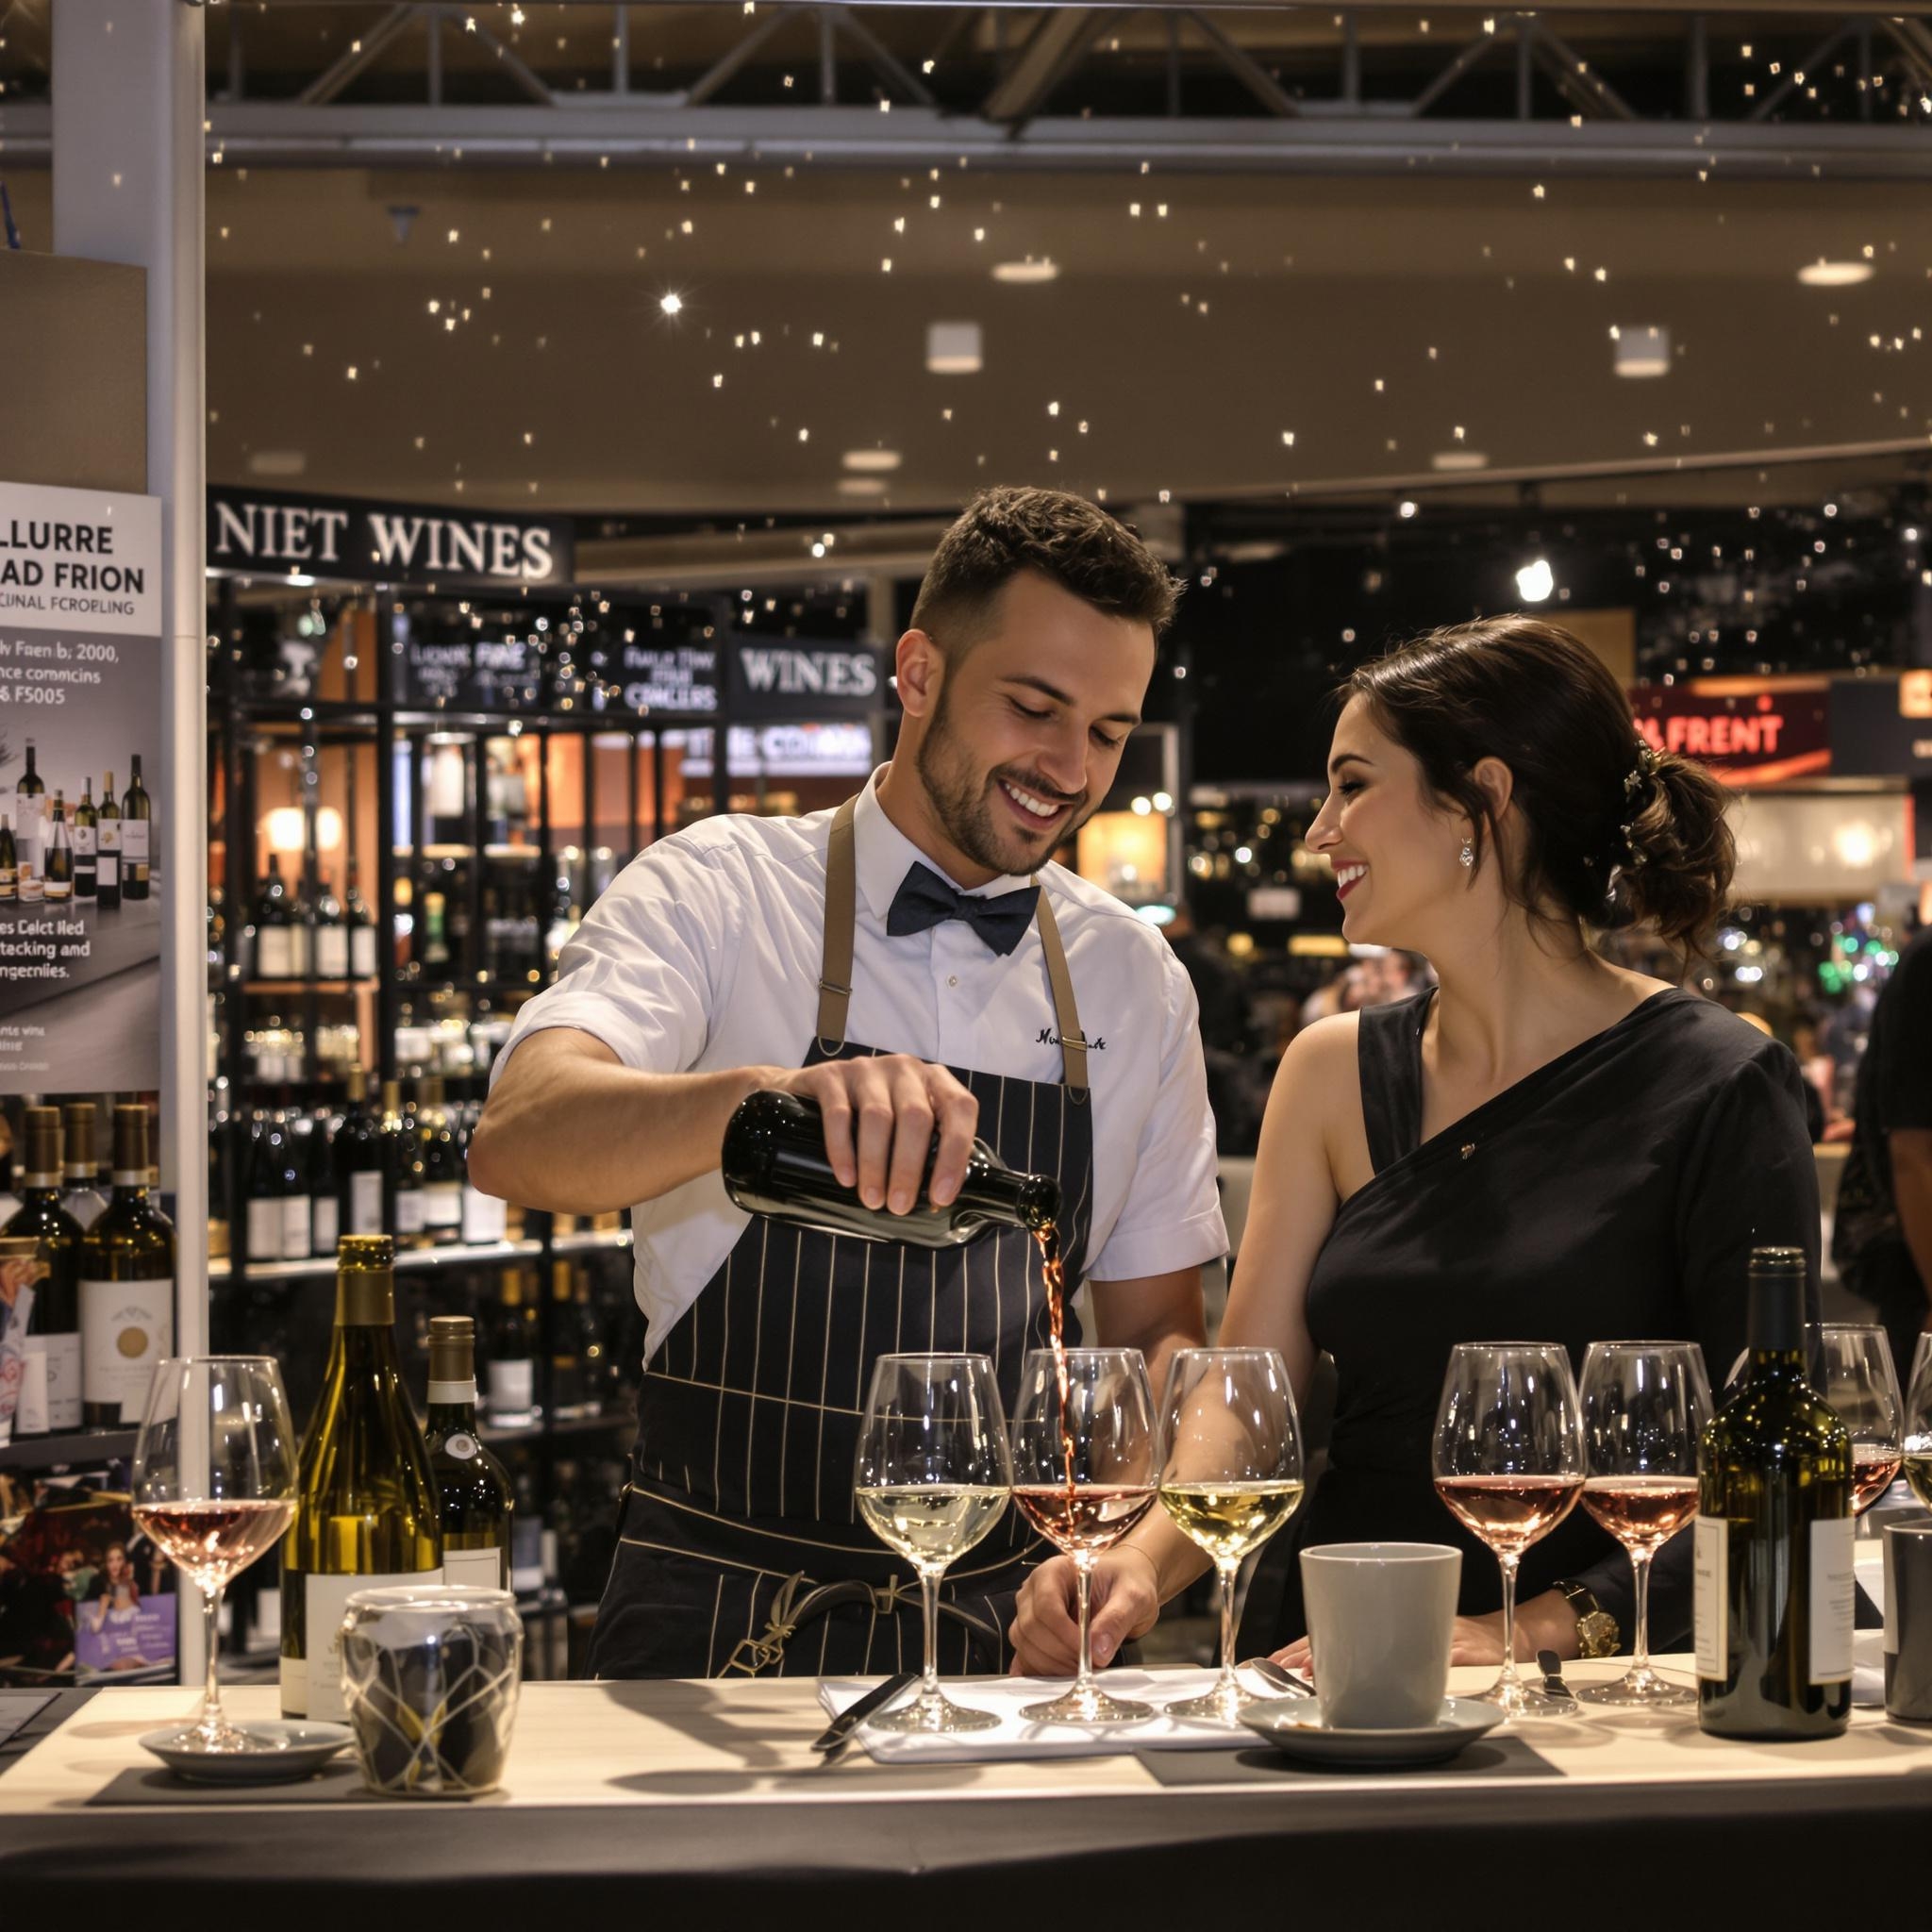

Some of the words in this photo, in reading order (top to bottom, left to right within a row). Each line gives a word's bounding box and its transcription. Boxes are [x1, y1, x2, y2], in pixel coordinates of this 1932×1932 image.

[215, 501, 349, 561] NIET
[367, 512, 553, 579] WINES
[54, 562, 144, 595] FRION
[76, 642, 119, 664] 2000,
[740, 647, 877, 696] WINES
[1666, 714, 1784, 755] FRENT
